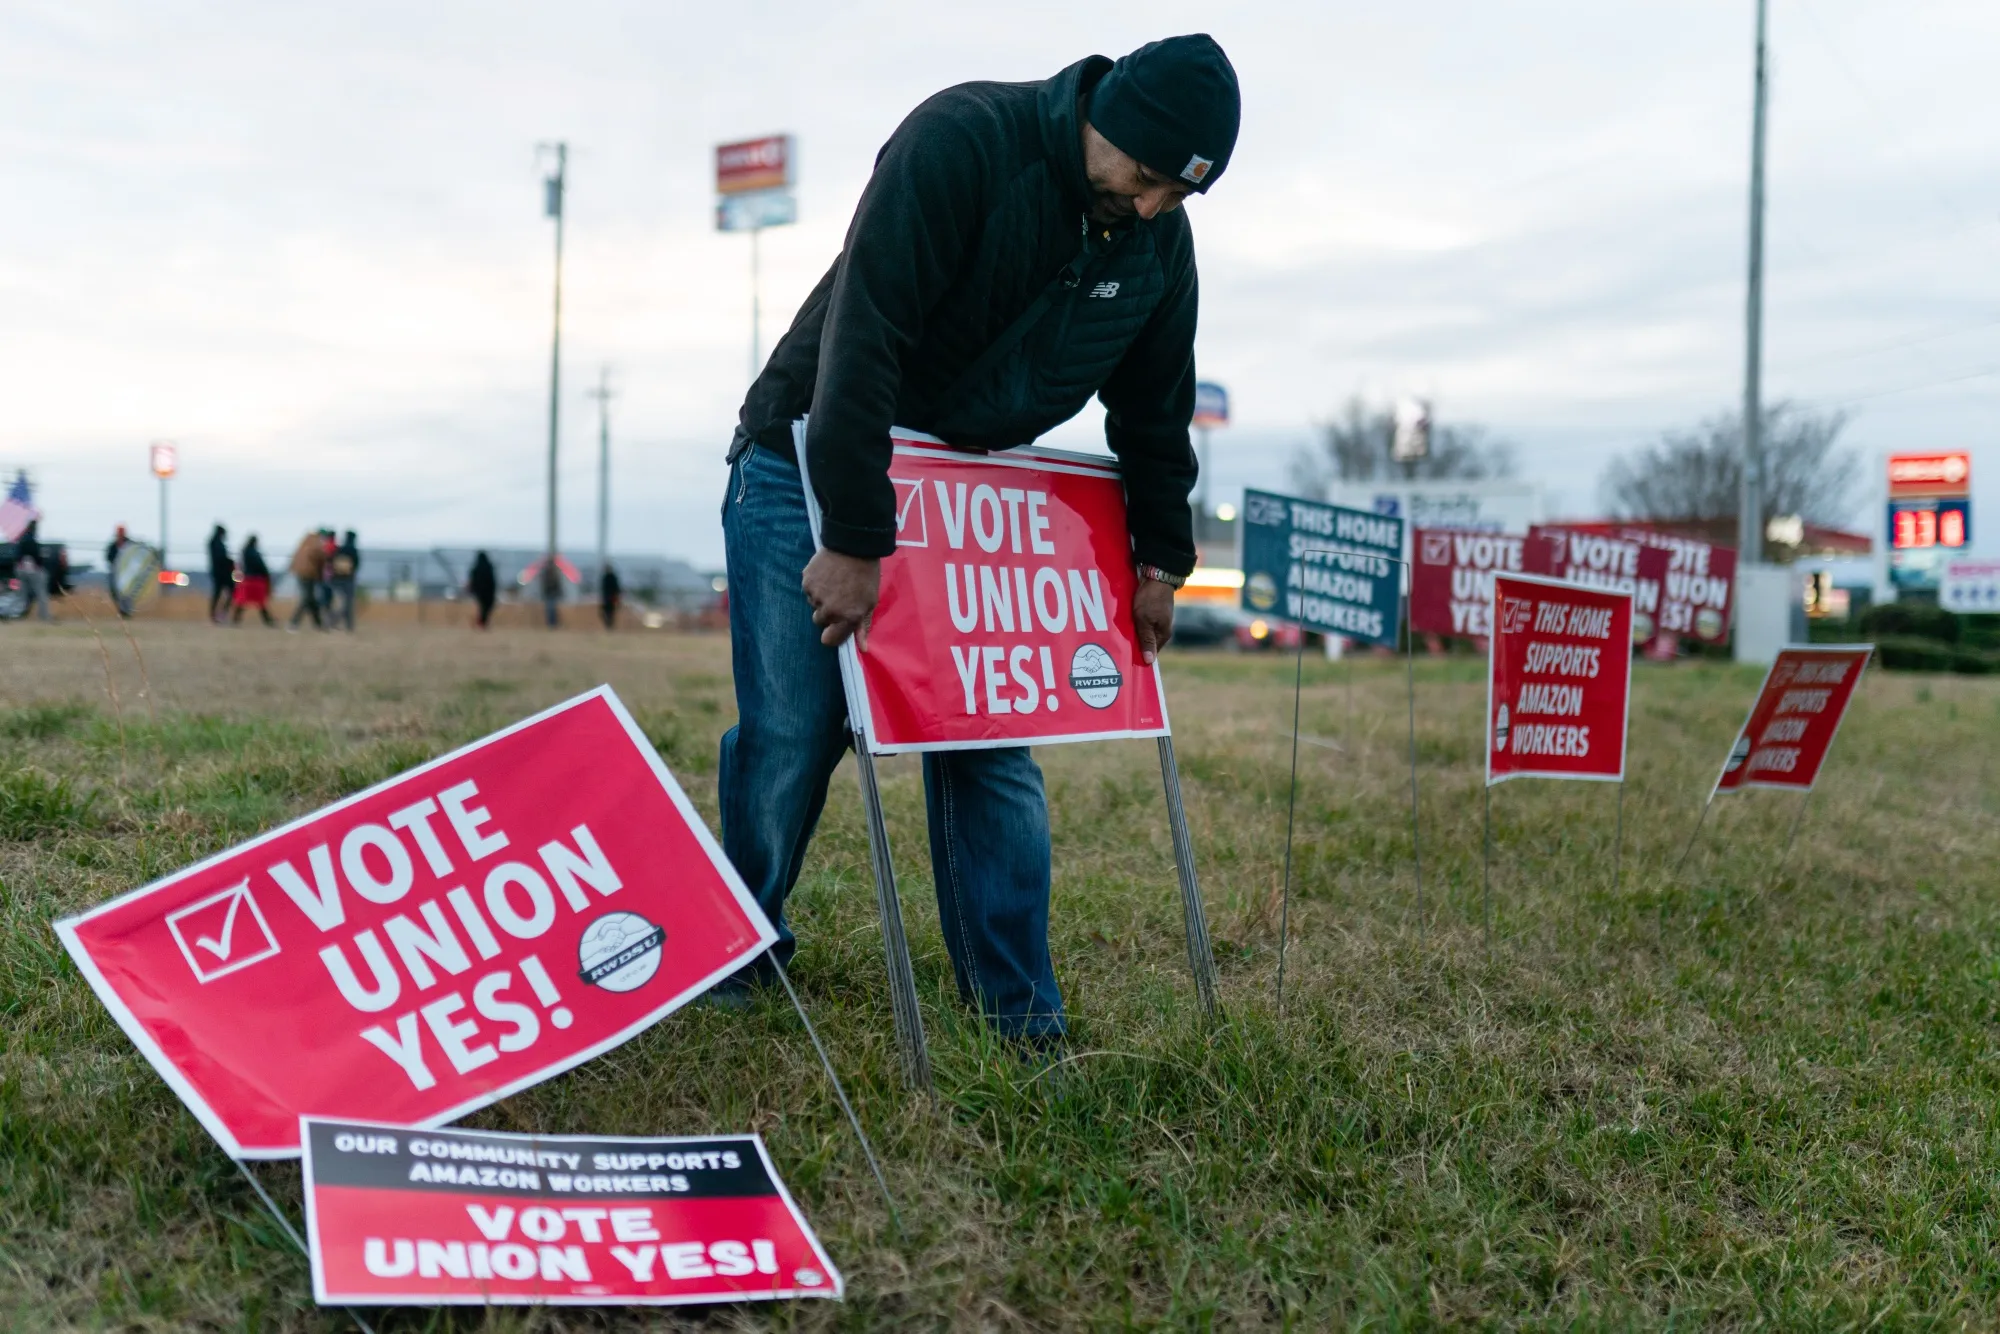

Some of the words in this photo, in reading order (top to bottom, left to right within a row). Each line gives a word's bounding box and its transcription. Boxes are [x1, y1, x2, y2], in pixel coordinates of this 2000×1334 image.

[934, 480, 1055, 555] VOTE
[1290, 503, 1334, 536] THIS
[1336, 513, 1399, 549] HOME
[1288, 531, 1390, 578] SUPPORTS
[1454, 534, 1523, 570] VOTE
[1569, 531, 1639, 576] VOTE
[1649, 534, 1712, 576] OTE
[945, 563, 1108, 634] UNION
[1287, 564, 1373, 605] AMAZON
[1286, 593, 1383, 638] WORKERS
[1534, 601, 1566, 635] THIS
[1567, 606, 1613, 640] HOME
[950, 645, 1059, 715] YES!
[1524, 641, 1600, 678] SUPPORTS
[1074, 678, 1119, 687] RWDSU
[1516, 682, 1583, 716] AMAZON
[1512, 722, 1590, 757] WORKERS
[267, 778, 510, 932] VOTE
[318, 823, 623, 1013] UNION
[590, 934, 658, 980] RWDSU
[359, 954, 574, 1091] YES!
[334, 1132, 397, 1155] OUR
[408, 1138, 581, 1170] COMMUNITY
[593, 1150, 742, 1171] SUPPORTS
[408, 1161, 541, 1190] AMAZON
[547, 1173, 690, 1192] WORKERS
[466, 1204, 660, 1242] VOTE
[364, 1237, 592, 1282] UNION
